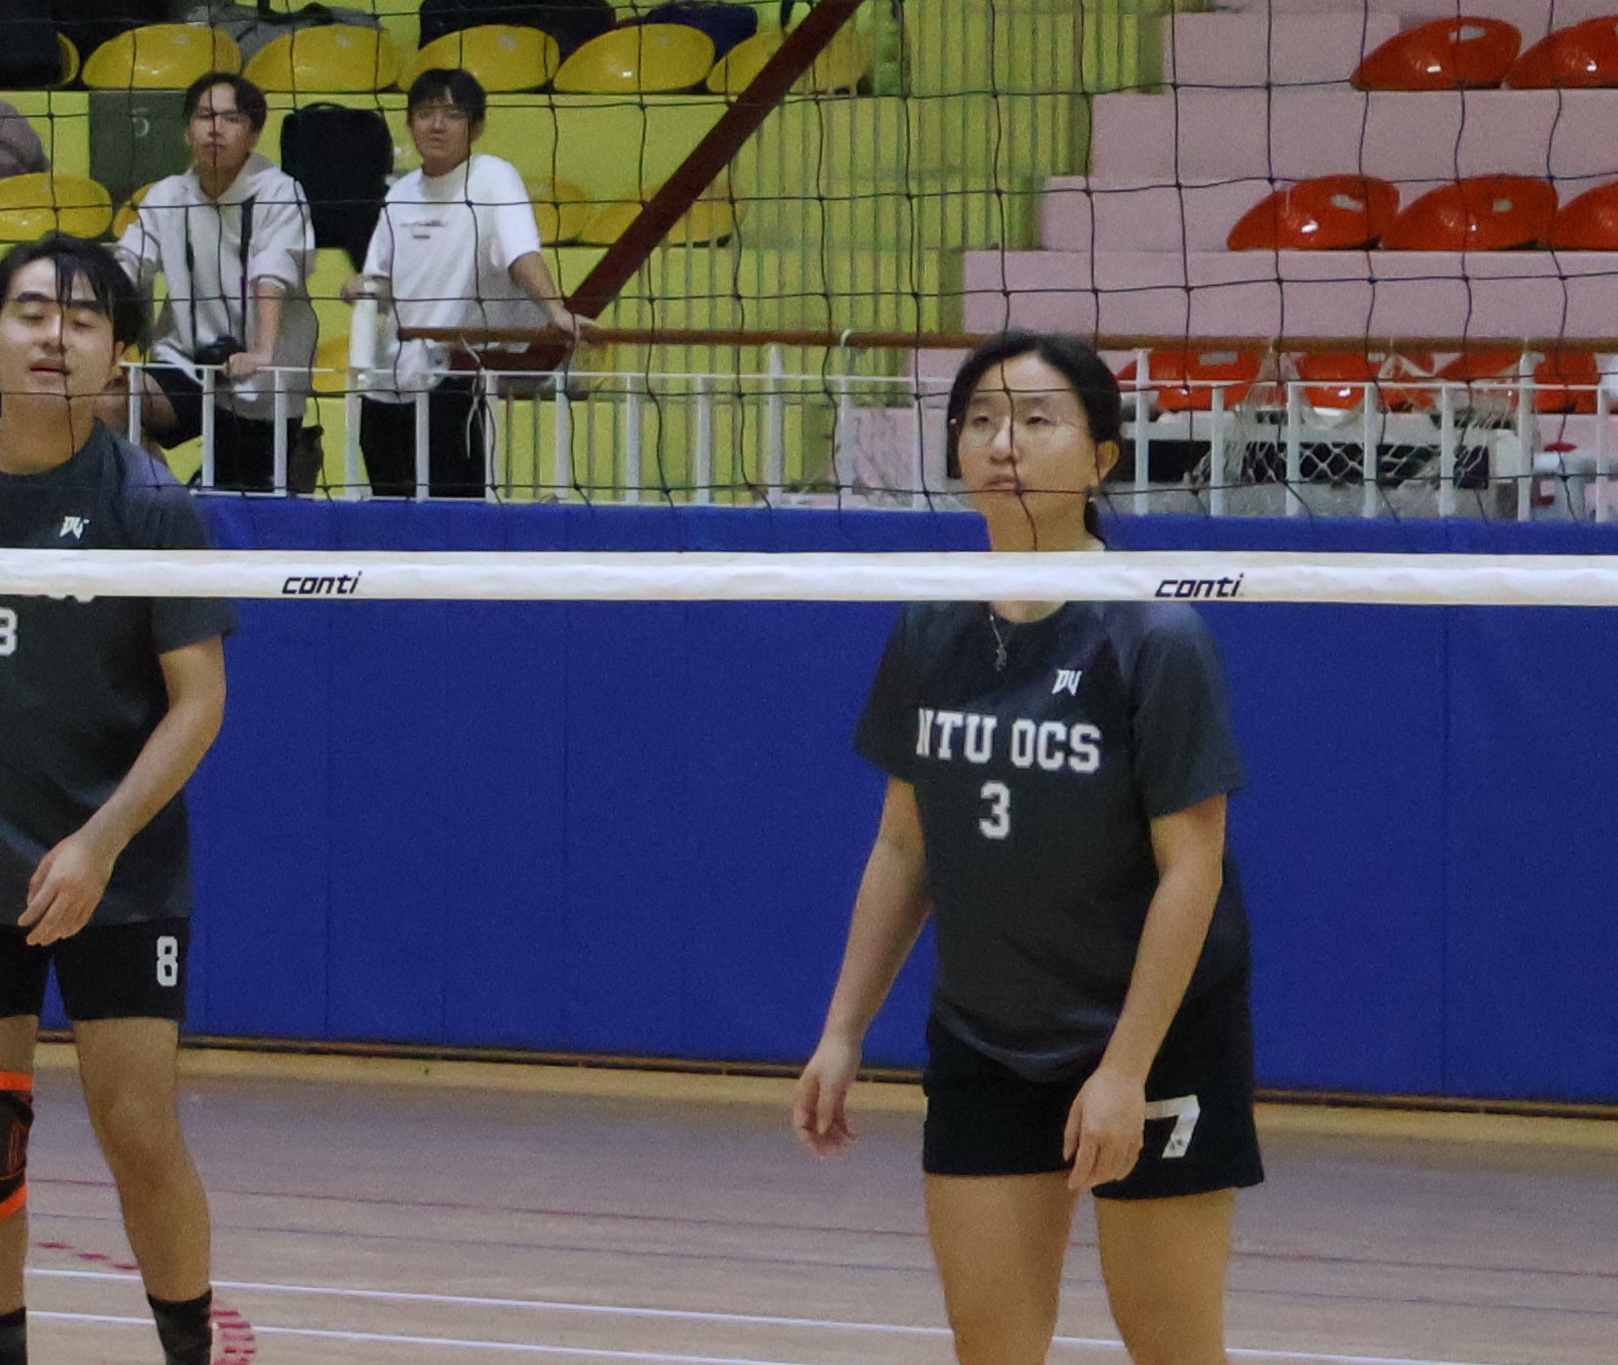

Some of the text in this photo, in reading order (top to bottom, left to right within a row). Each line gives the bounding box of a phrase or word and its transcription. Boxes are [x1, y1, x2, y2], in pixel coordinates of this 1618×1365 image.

[281, 570, 363, 595] conti
[1154, 572, 1244, 599] conti
[915, 706, 1103, 774] NTU OCS
[978, 780, 1012, 841] 3
[155, 934, 179, 987] 8
